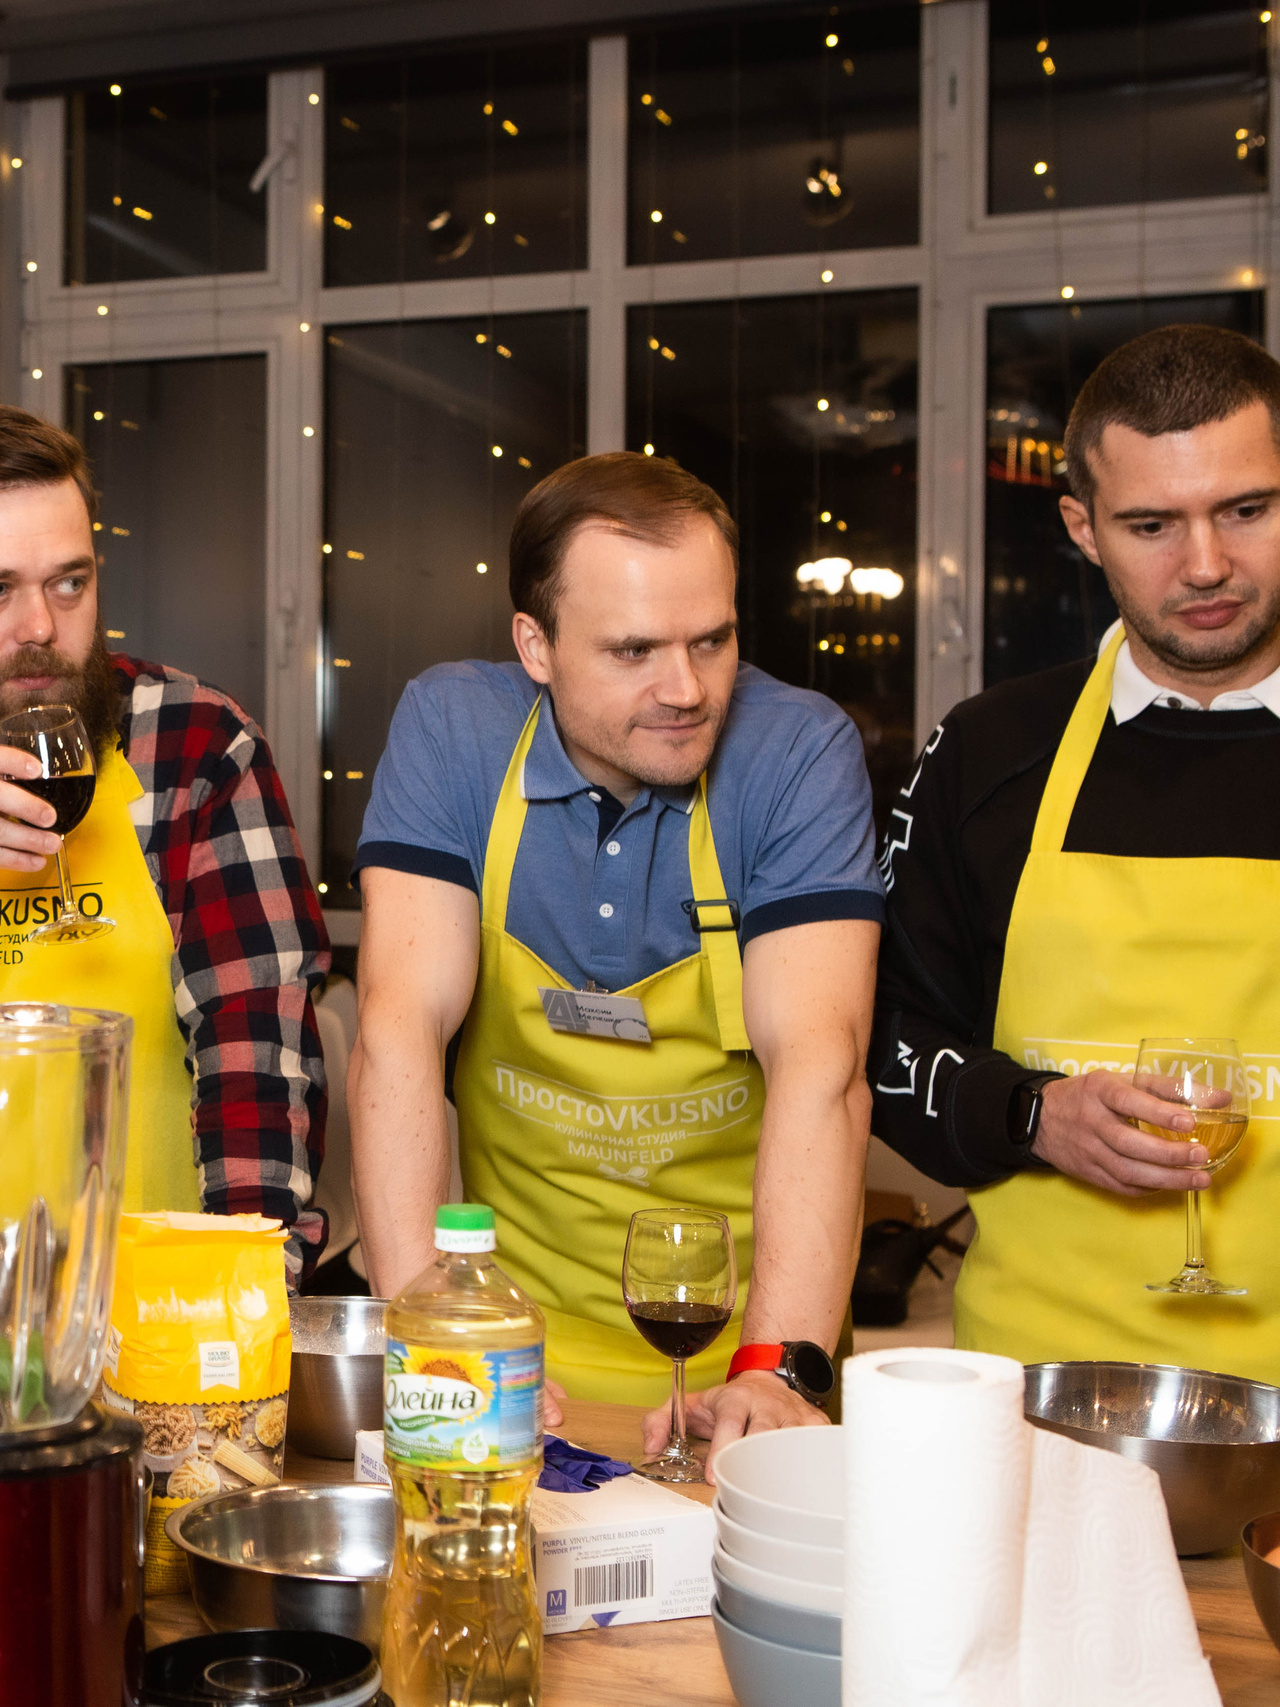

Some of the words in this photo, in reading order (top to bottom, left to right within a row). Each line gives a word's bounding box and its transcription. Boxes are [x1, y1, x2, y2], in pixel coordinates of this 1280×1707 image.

[495, 1066, 750, 1131] ПростоVKUSNO
[554, 1120, 634, 1147] КУЛИНАРНАЯ
[636, 1129, 687, 1147] СТУДИЯ
[567, 1140, 674, 1164] MAUNFELD
[386, 1379, 476, 1410] Олейна
[542, 1539, 567, 1548] PURPLE
[570, 1533, 616, 1545] VINYL/NITRILE
[618, 1530, 639, 1539] BLEND
[640, 1527, 665, 1537] GLOVES
[543, 1547, 568, 1556] POWDER
[550, 1591, 563, 1607] M
